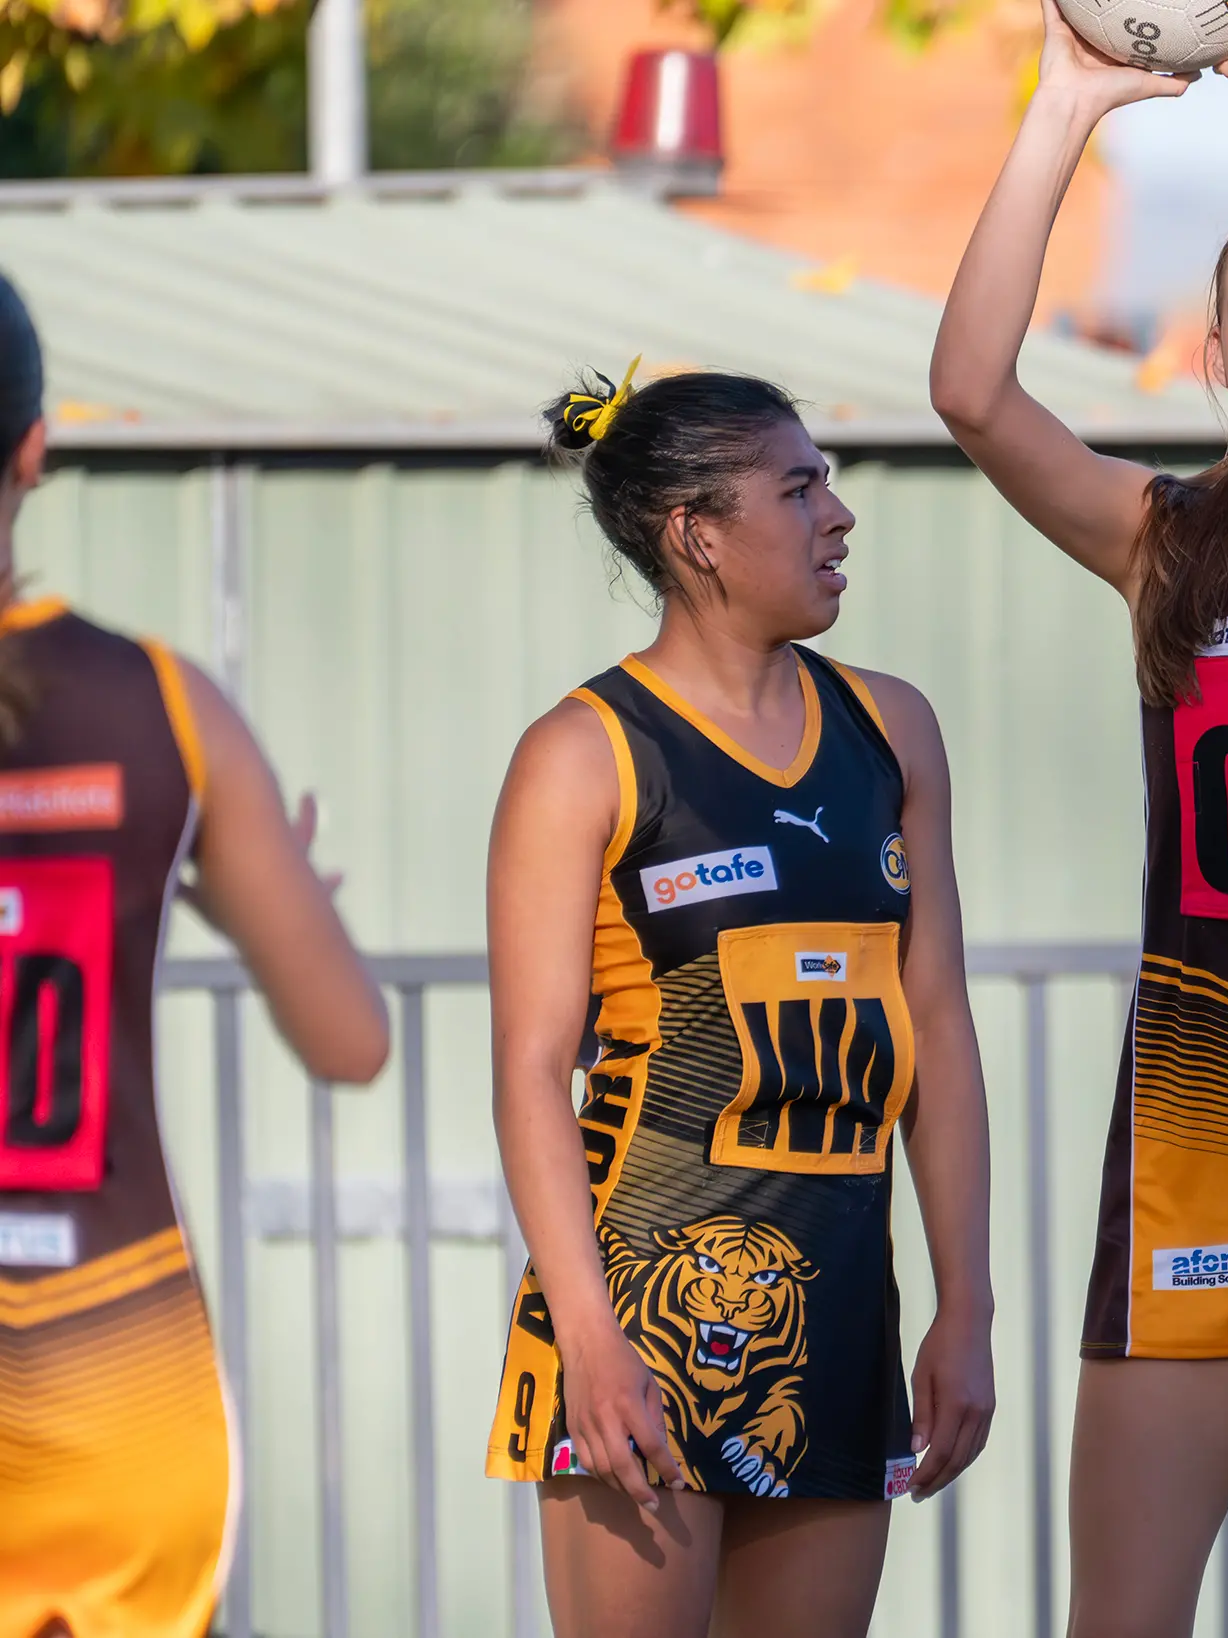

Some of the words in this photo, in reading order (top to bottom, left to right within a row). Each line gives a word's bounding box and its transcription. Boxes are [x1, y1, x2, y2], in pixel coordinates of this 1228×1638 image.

[653, 853, 764, 905] gotafe
[0, 953, 84, 1149] D
[737, 998, 896, 1155] WA
[1172, 1273, 1216, 1287] Building
